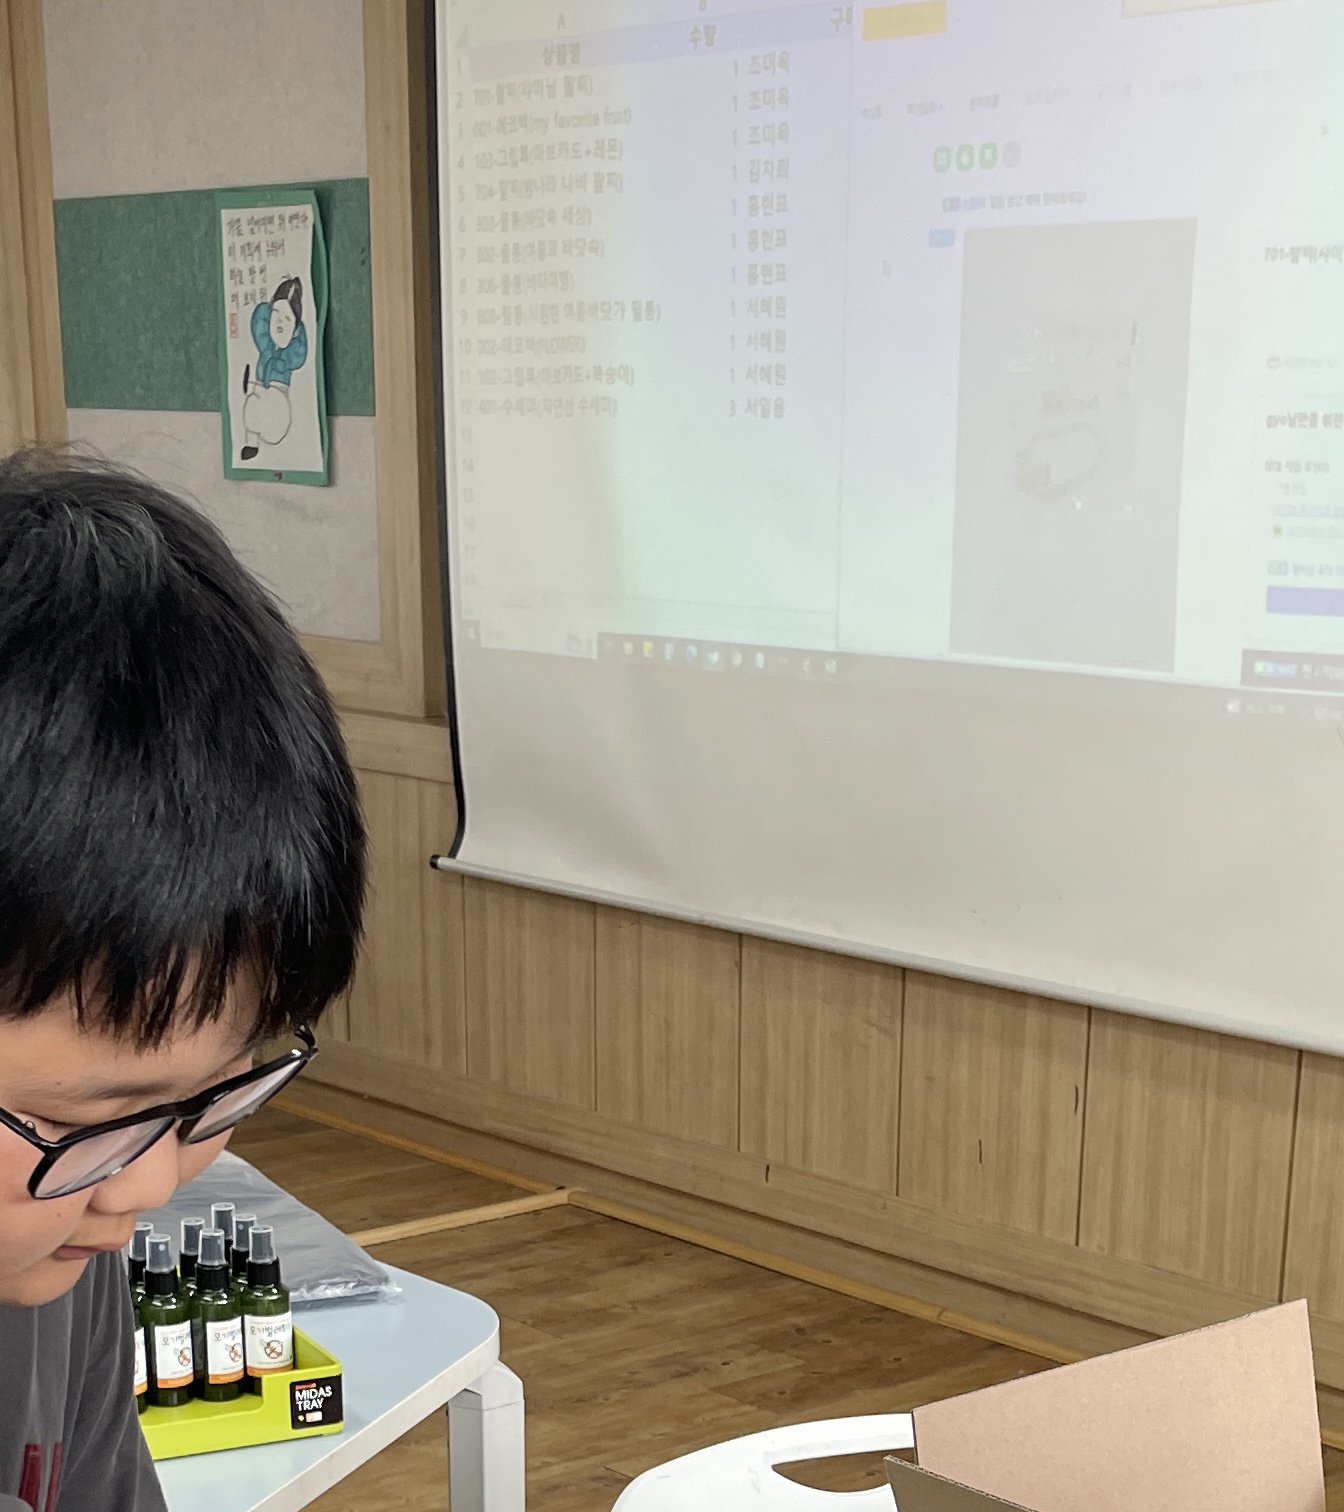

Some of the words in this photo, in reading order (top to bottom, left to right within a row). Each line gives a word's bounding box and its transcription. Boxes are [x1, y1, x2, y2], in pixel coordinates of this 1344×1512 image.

[689, 24, 718, 49] 수량
[554, 109, 599, 128] favorite
[296, 1385, 332, 1401] MIDAS
[296, 1398, 324, 1411] TRAY
